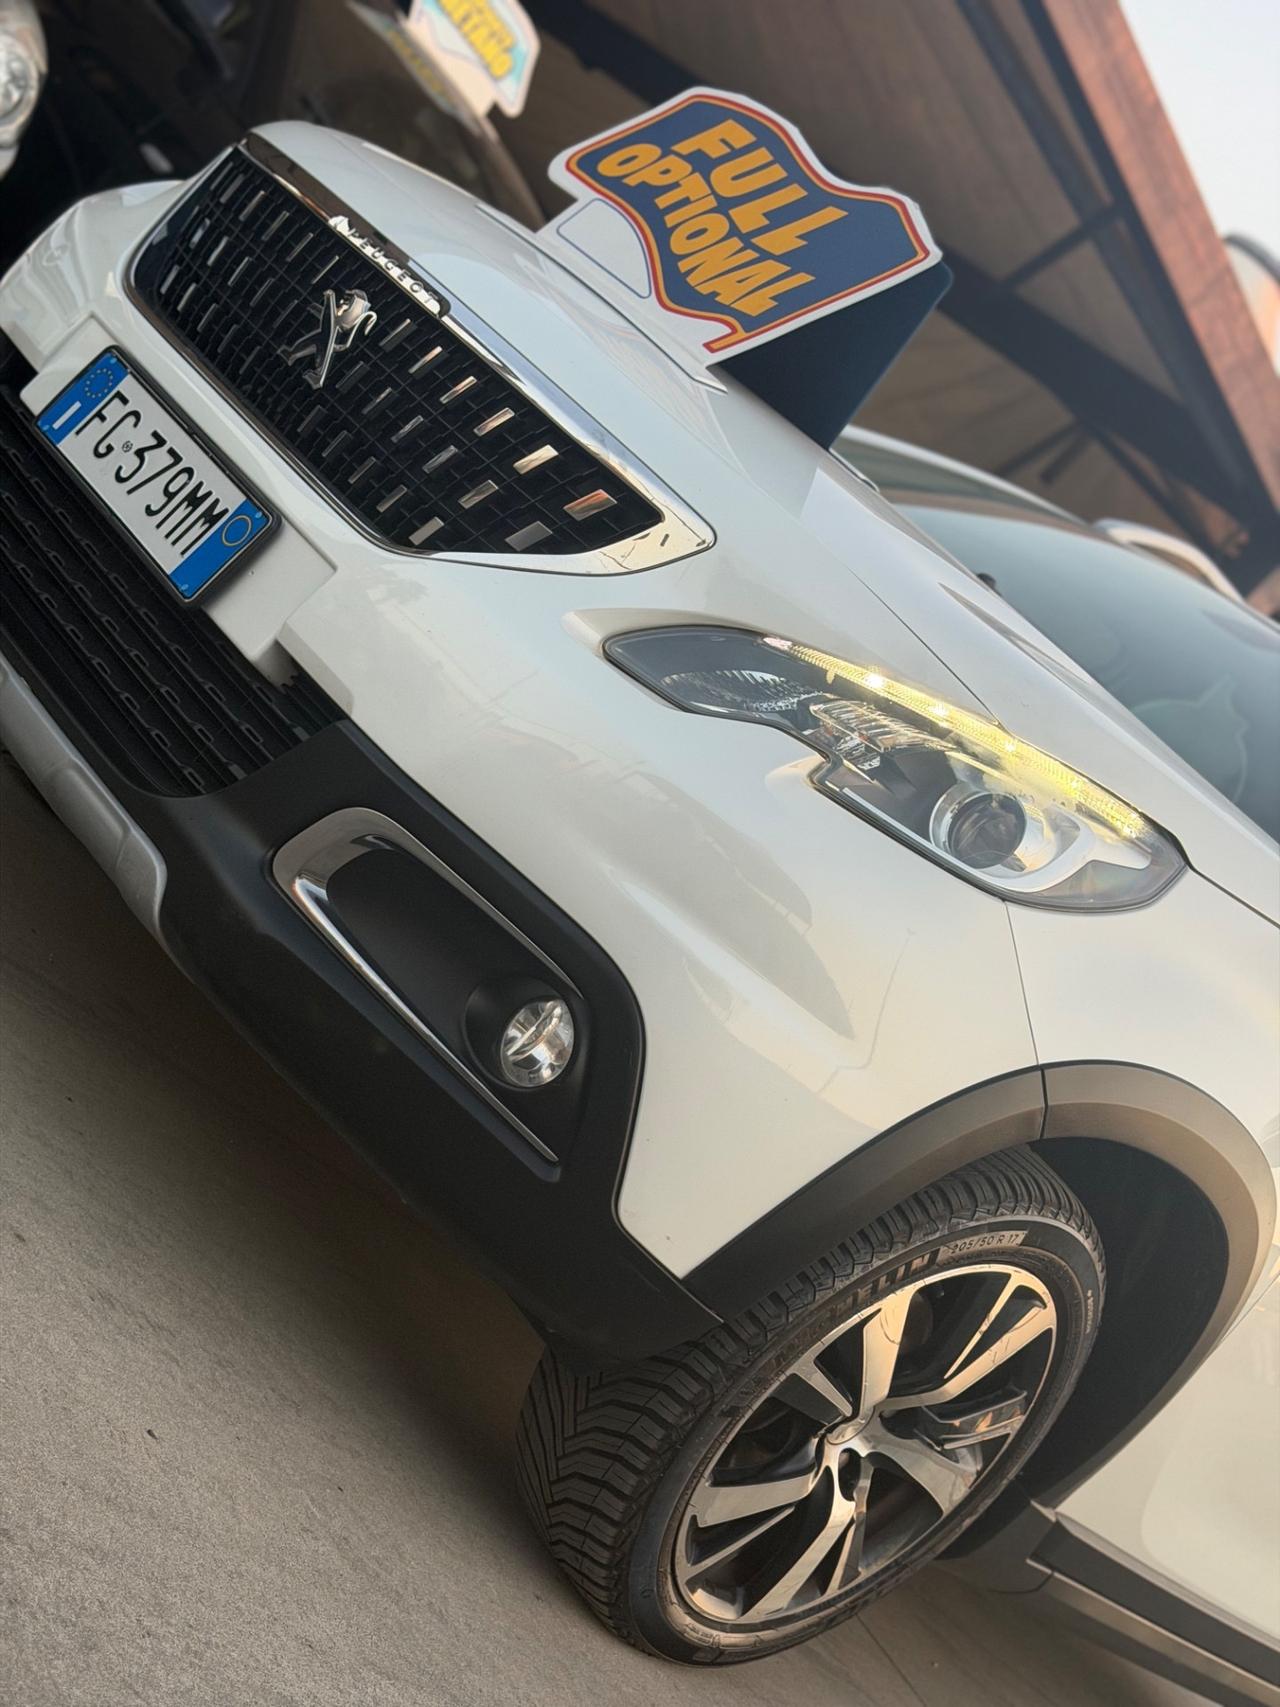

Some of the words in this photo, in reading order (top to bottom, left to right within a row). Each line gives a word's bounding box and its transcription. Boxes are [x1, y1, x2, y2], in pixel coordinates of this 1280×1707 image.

[597, 143, 816, 316] OPTIONAL
[670, 118, 849, 257] FULL
[346, 227, 439, 304] PEUGEOT
